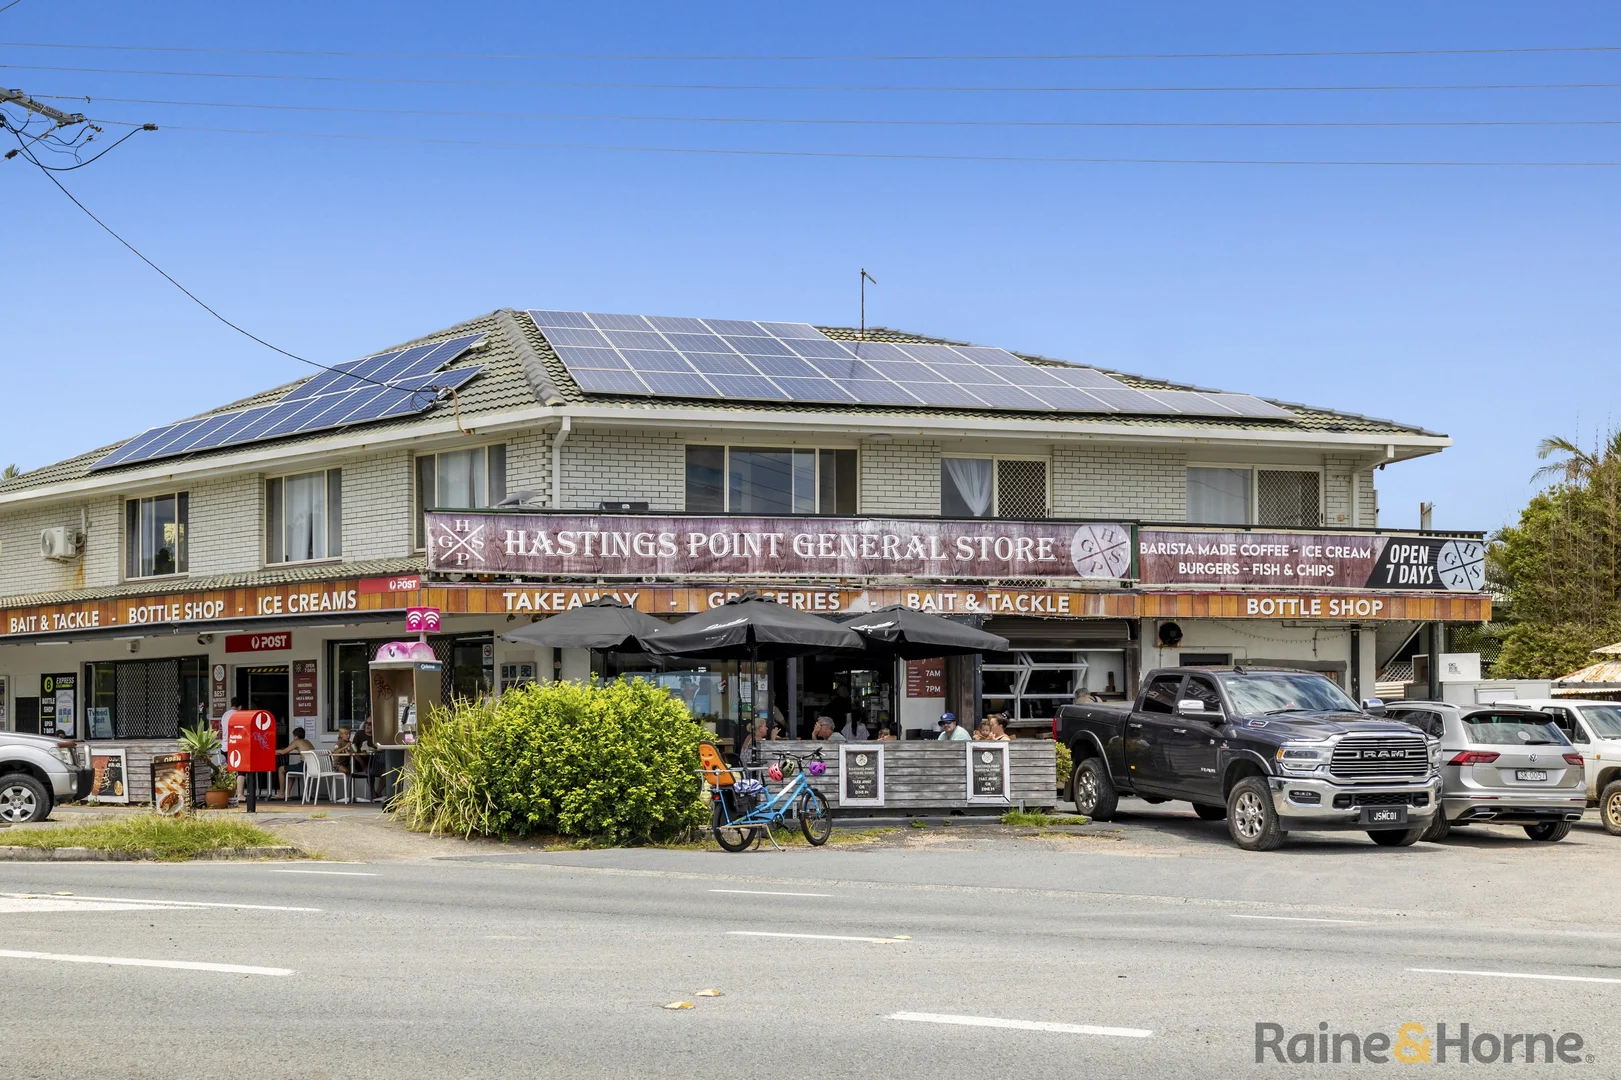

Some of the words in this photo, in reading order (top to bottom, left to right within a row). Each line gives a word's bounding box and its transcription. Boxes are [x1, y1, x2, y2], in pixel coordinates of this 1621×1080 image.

[455, 519, 470, 532] H
[438, 535, 454, 548] G
[472, 536, 485, 549] S
[504, 530, 678, 559] HASTINGS
[687, 532, 784, 558] POINT
[792, 533, 949, 561] GENERAL
[956, 536, 1057, 563] STORE
[1140, 542, 1194, 555] BARISTA
[1198, 544, 1237, 556] MADE
[1240, 544, 1290, 556] COFFEE
[1302, 545, 1322, 557] ICE
[1325, 546, 1371, 558] CREAM
[1390, 544, 1429, 564] OPEN
[456, 553, 470, 565] P
[1178, 562, 1240, 575] BURGERS
[1252, 563, 1280, 575] FISH
[1283, 563, 1294, 576] &
[1297, 564, 1334, 576] CHIPS
[1386, 564, 1395, 583] 7
[1398, 565, 1434, 584] DAYS
[397, 580, 417, 589] POST
[708, 591, 840, 610] GRERIES
[907, 593, 957, 610] BAIT
[965, 593, 980, 611] &
[987, 593, 1070, 613] TACKLE
[1247, 598, 1321, 615] BOTTLE
[1329, 599, 1383, 616] SHOP
[10, 616, 37, 633] BAIT
[40, 615, 49, 631] &
[53, 610, 99, 629] TACKLE
[129, 604, 180, 623] BOTTLE
[185, 600, 224, 620] SHOP
[258, 596, 282, 615] ICE
[288, 589, 357, 613] CREAMS
[261, 635, 287, 648] POST
[88, 709, 108, 717] Tweed
[1363, 750, 1404, 758] RAM
